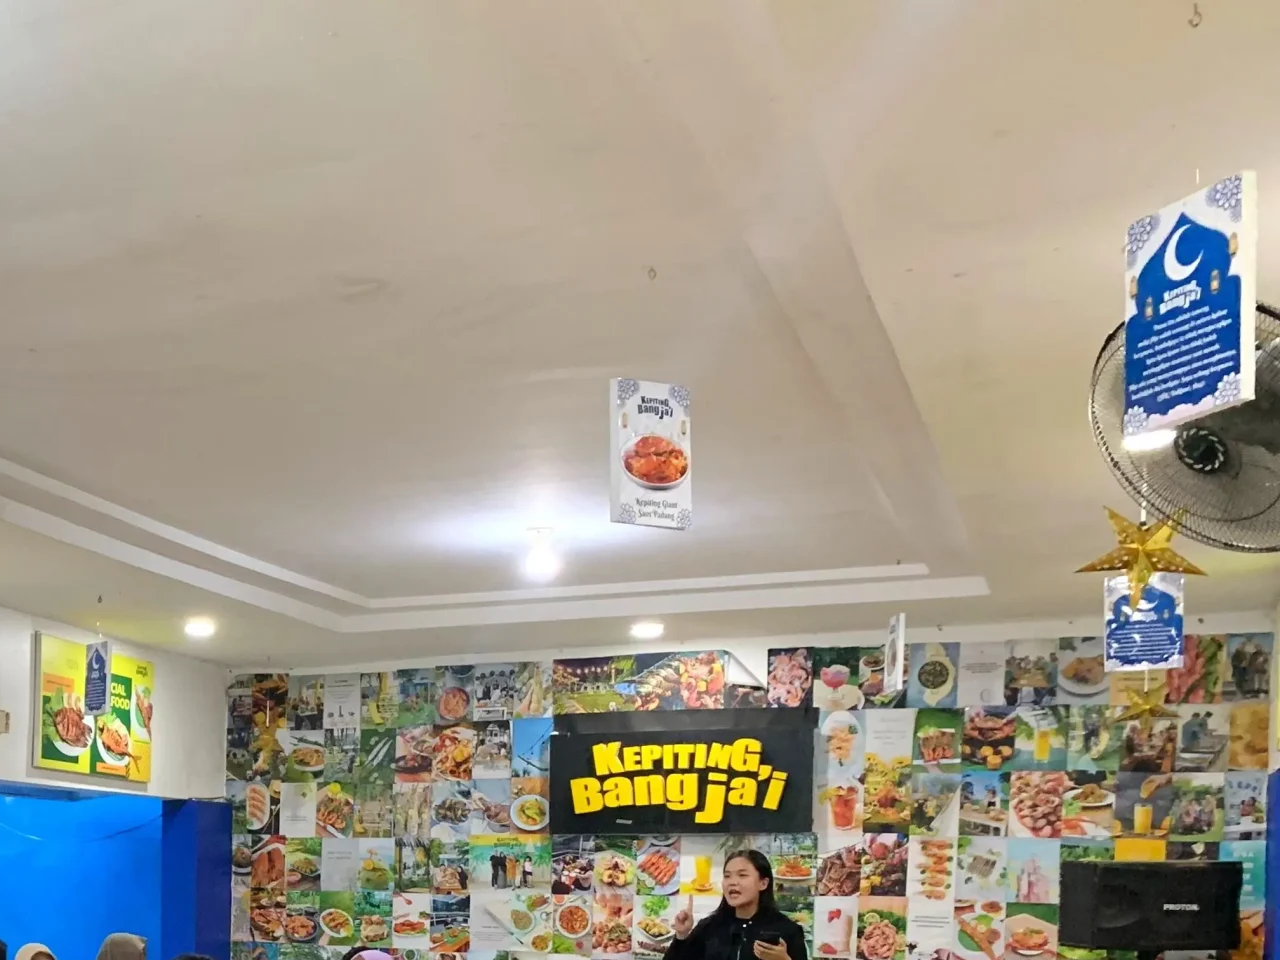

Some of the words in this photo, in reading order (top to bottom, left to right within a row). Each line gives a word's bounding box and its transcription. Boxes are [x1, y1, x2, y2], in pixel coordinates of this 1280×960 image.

[110, 682, 126, 696] CIAL
[110, 696, 130, 711] FOOD
[591, 737, 763, 776] KEPITING
